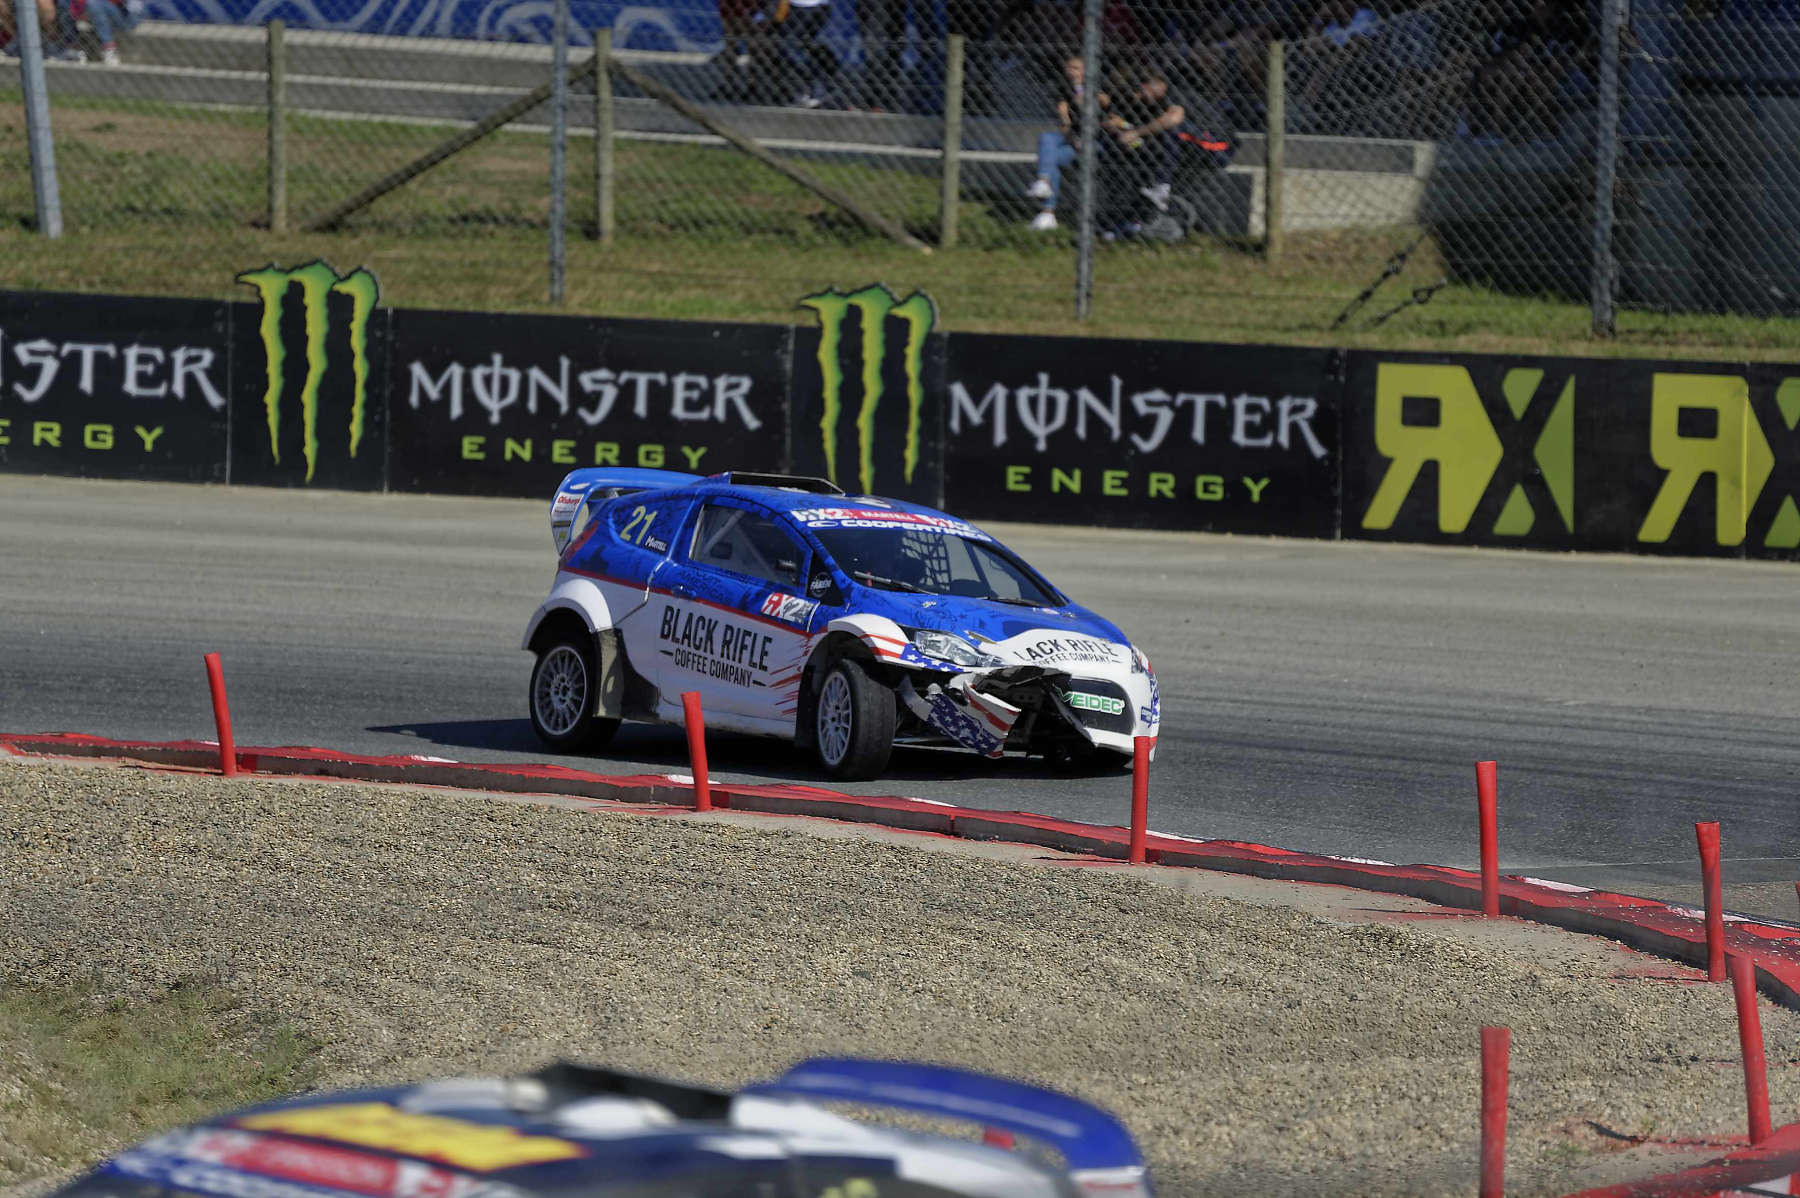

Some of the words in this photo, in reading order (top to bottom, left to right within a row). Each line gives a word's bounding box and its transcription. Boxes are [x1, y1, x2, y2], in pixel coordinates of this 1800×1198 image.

[0, 328, 226, 411] STER
[408, 352, 763, 431] MONSTER
[949, 372, 1328, 459] MONSTER
[461, 435, 708, 469] ENERGY
[1005, 465, 1270, 503] ENERGY
[620, 505, 658, 545] 21
[660, 605, 719, 656] BLACK
[720, 623, 772, 672] RIFLE
[1064, 639, 1118, 657] RIFLE
[675, 647, 707, 675] COFFEE
[709, 659, 753, 688] COMPANY
[1069, 653, 1110, 665] COMPANY
